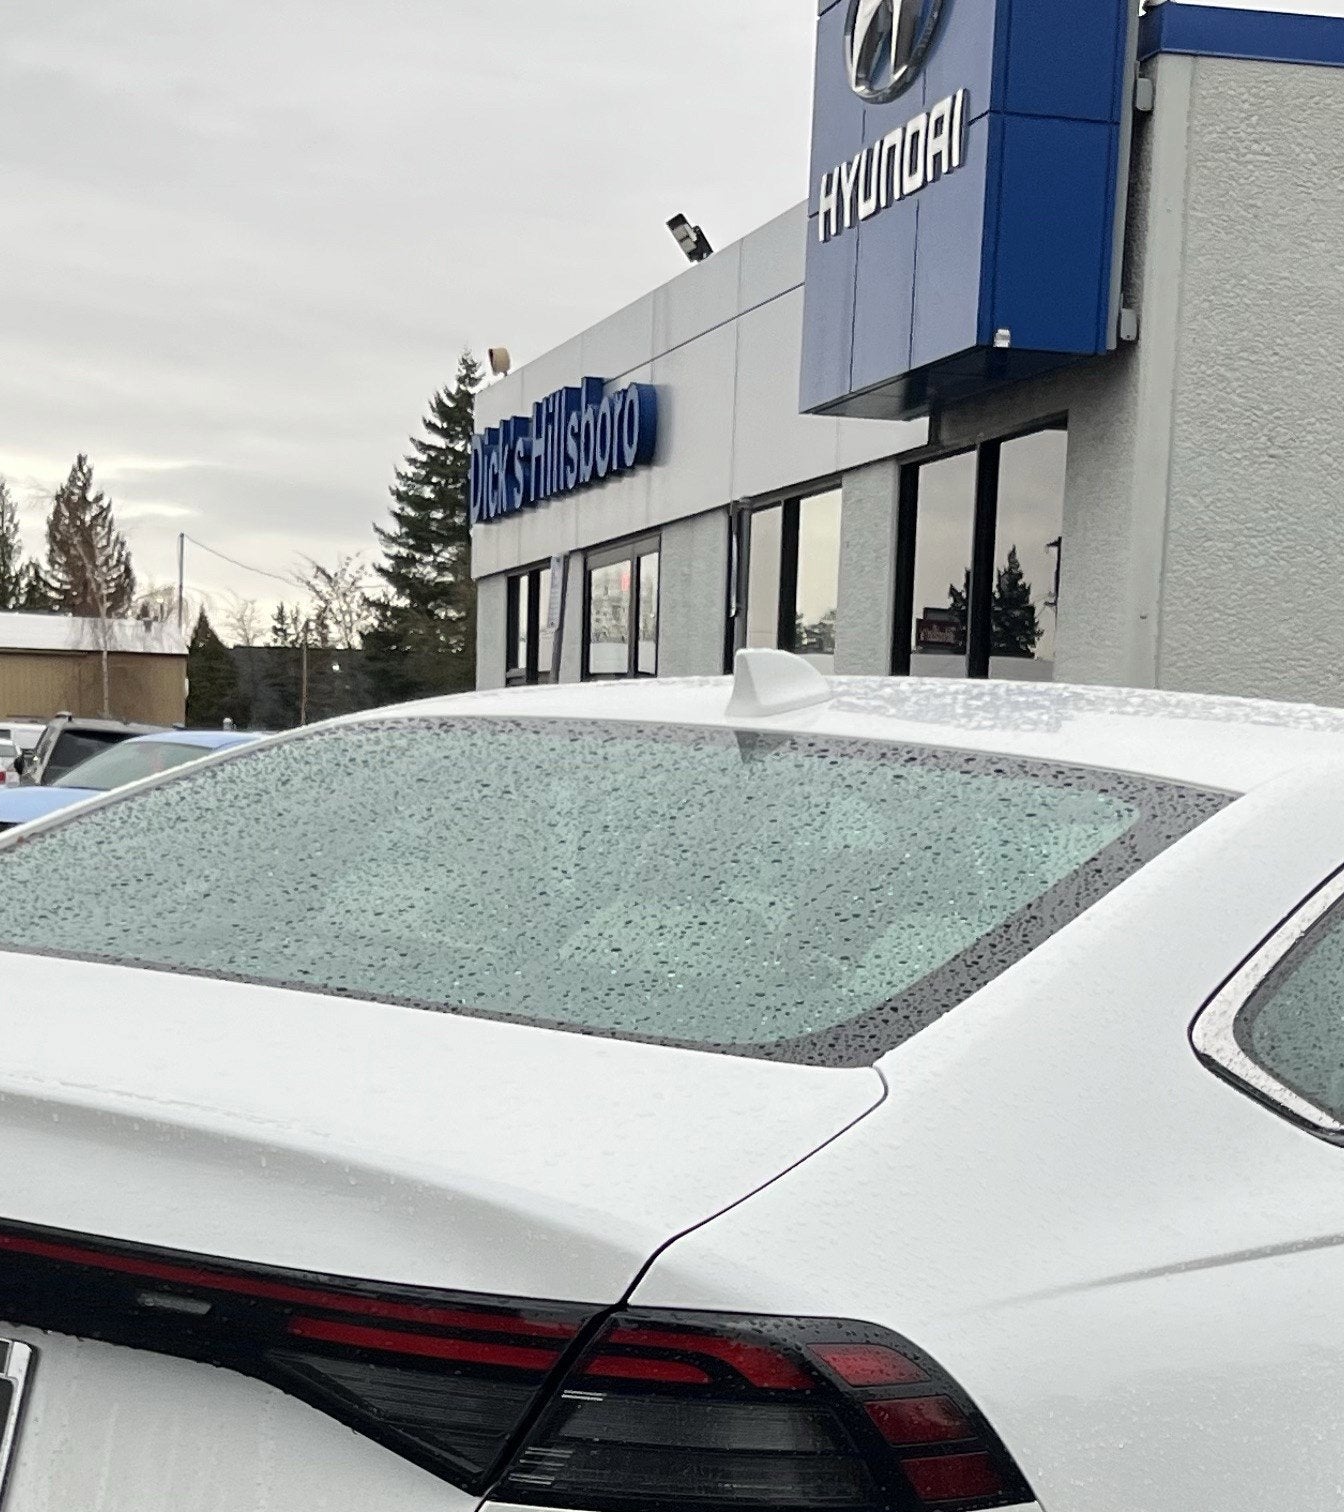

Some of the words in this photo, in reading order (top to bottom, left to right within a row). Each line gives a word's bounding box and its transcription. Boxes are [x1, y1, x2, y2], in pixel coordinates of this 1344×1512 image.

[818, 88, 967, 242] HYUNDAI
[469, 415, 526, 525] Dick's
[530, 376, 644, 502] Hillsboro
